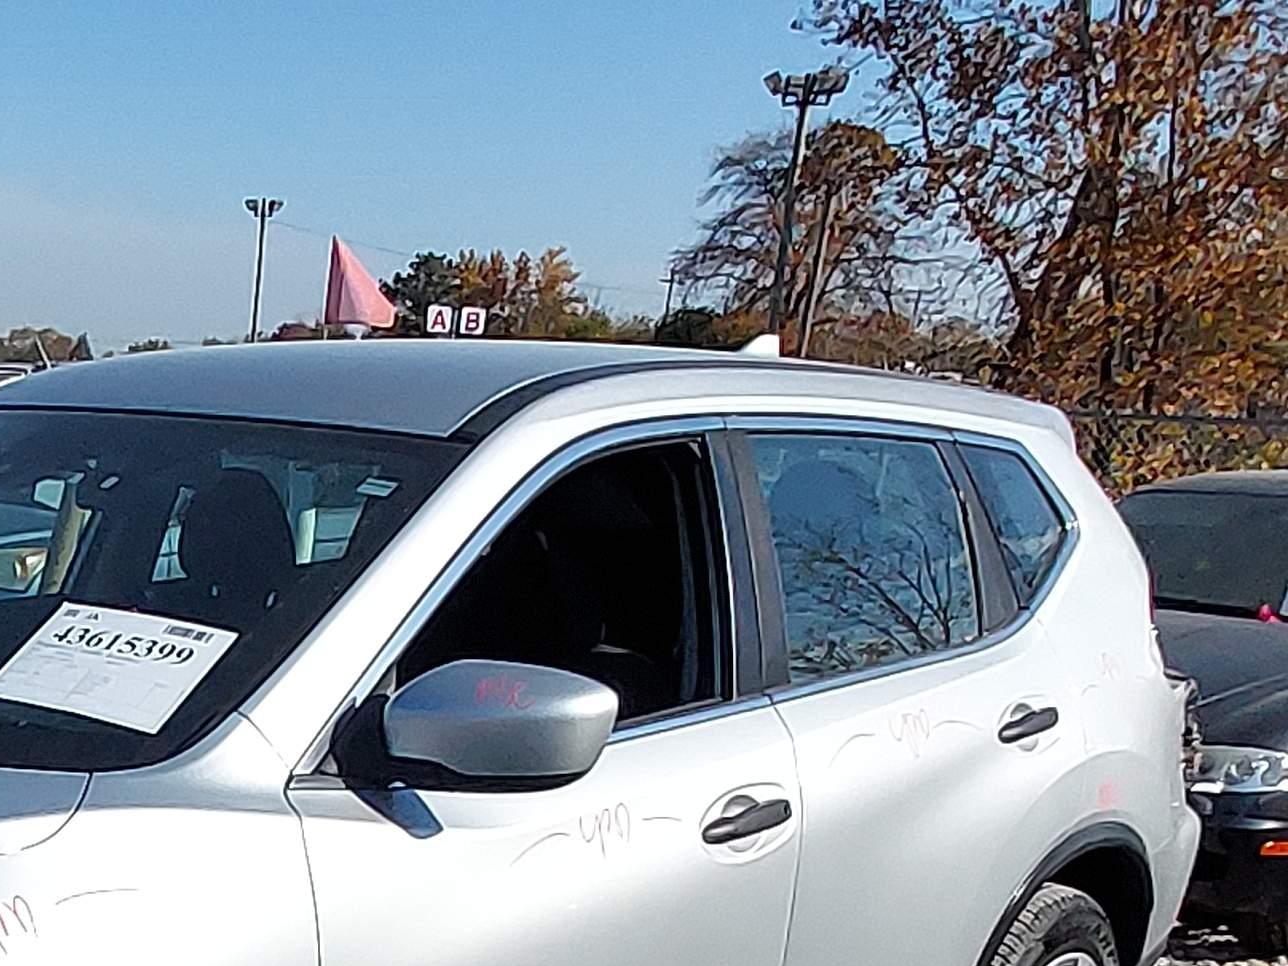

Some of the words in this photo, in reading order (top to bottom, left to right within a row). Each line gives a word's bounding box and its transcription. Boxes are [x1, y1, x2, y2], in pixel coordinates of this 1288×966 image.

[430, 308, 447, 331] A
[464, 311, 481, 332] B
[52, 625, 195, 665] 43615399
